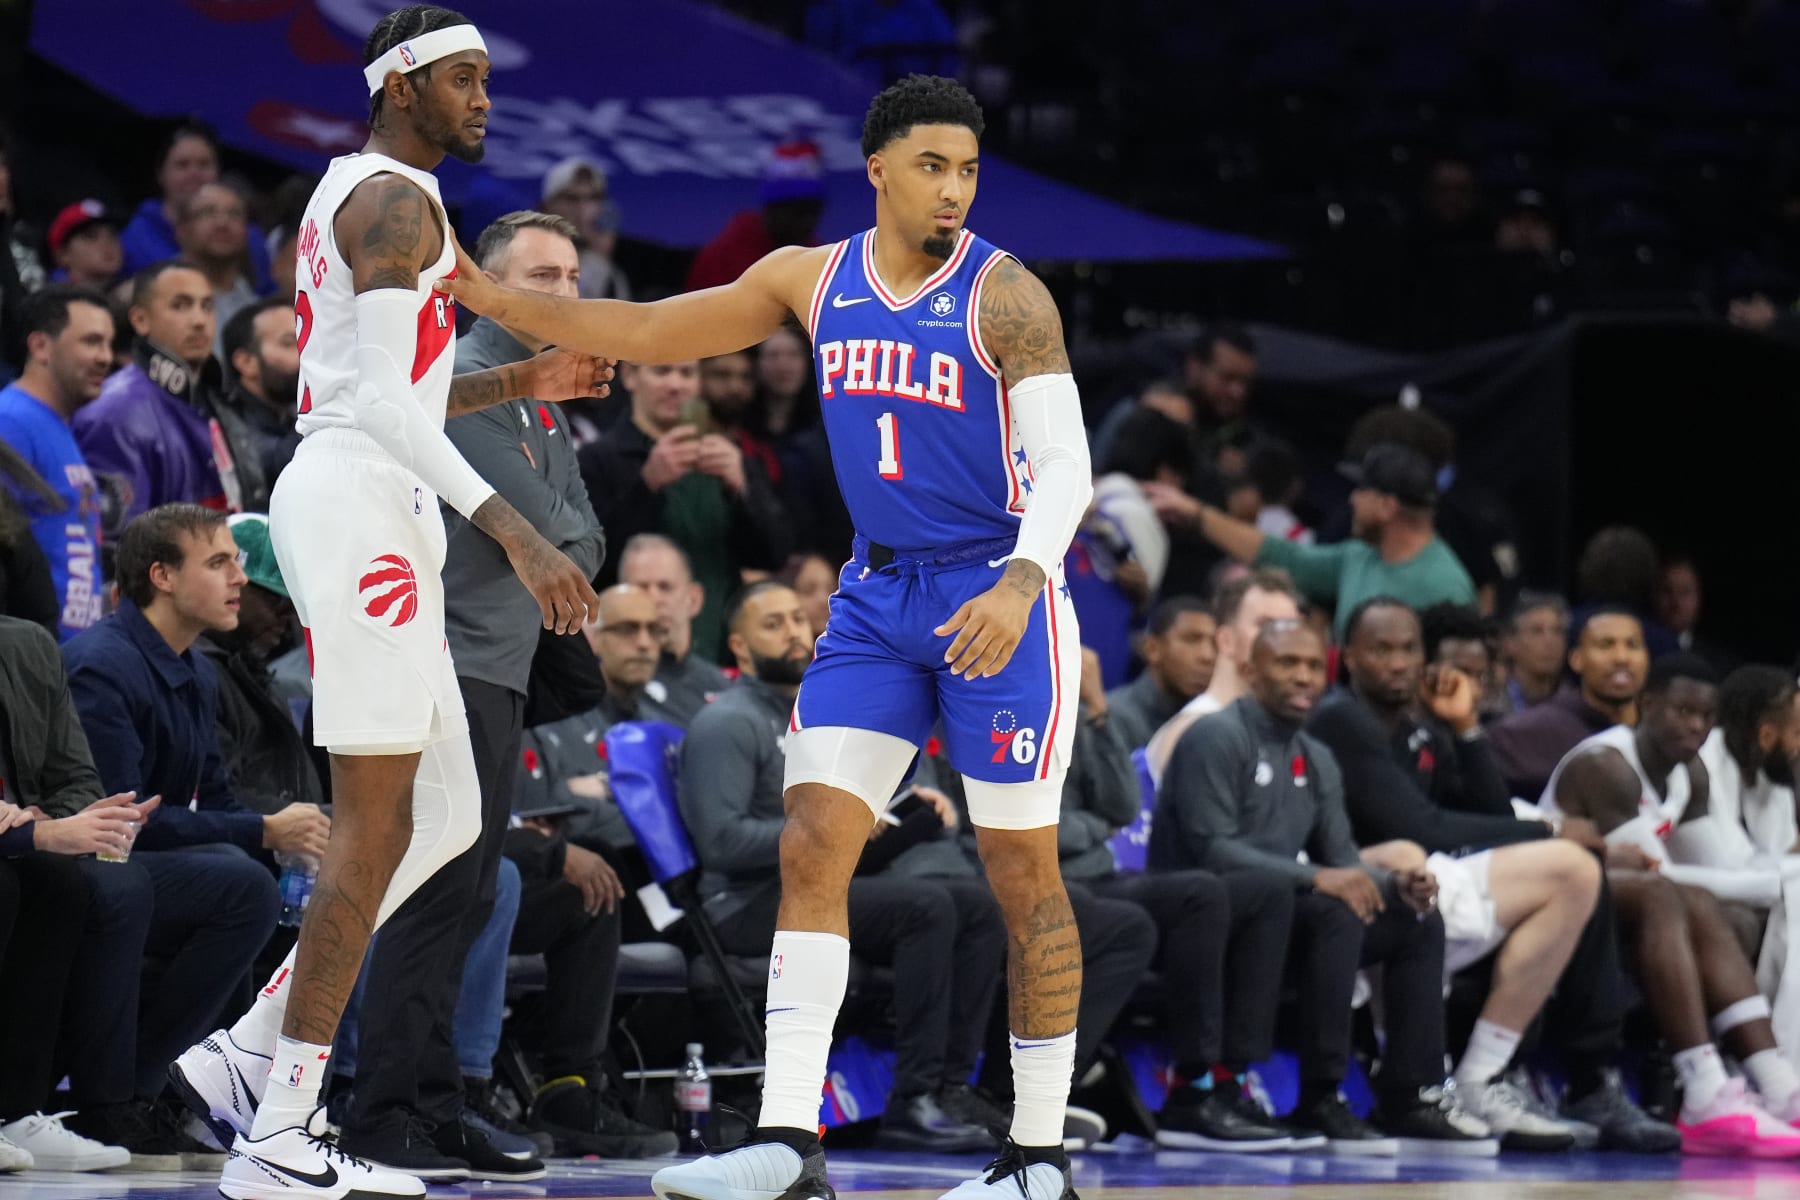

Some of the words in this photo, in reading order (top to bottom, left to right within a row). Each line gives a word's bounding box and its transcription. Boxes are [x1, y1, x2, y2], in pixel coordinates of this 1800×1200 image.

[917, 320, 963, 328] crypto.com
[820, 339, 967, 413] PHILA
[876, 412, 904, 480] 1
[990, 727, 1036, 765] 76
